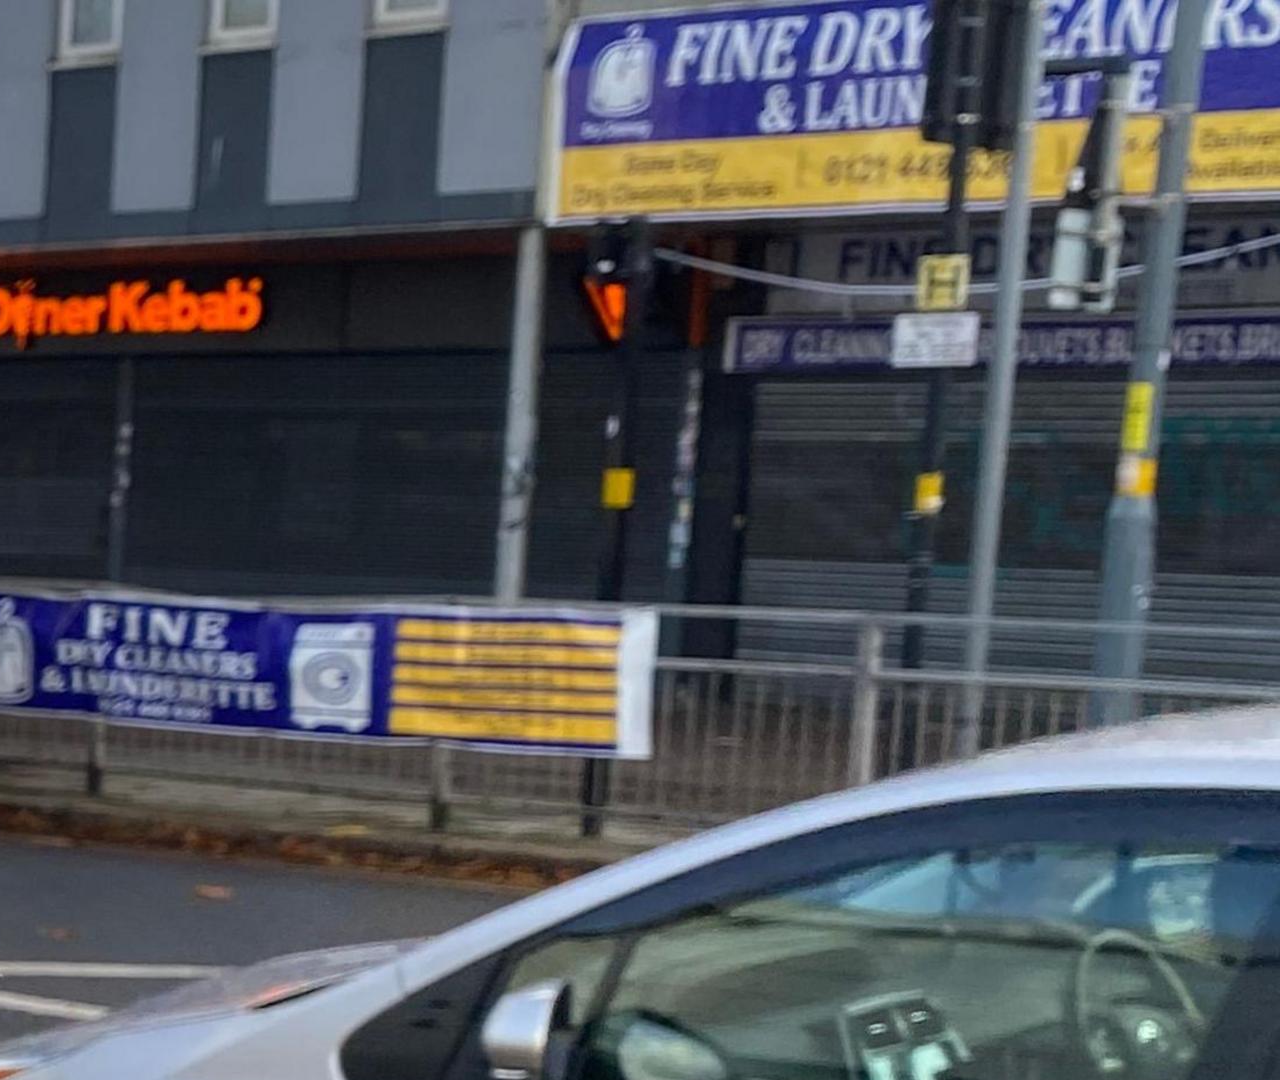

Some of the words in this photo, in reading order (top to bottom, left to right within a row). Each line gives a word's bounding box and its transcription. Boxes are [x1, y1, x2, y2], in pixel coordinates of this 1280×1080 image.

[665, 14, 809, 87] FINE
[809, 3, 932, 77] DRY
[757, 83, 797, 133] &
[109, 277, 263, 333] Kebab
[87, 602, 229, 650] FINE
[41, 664, 68, 693] &
